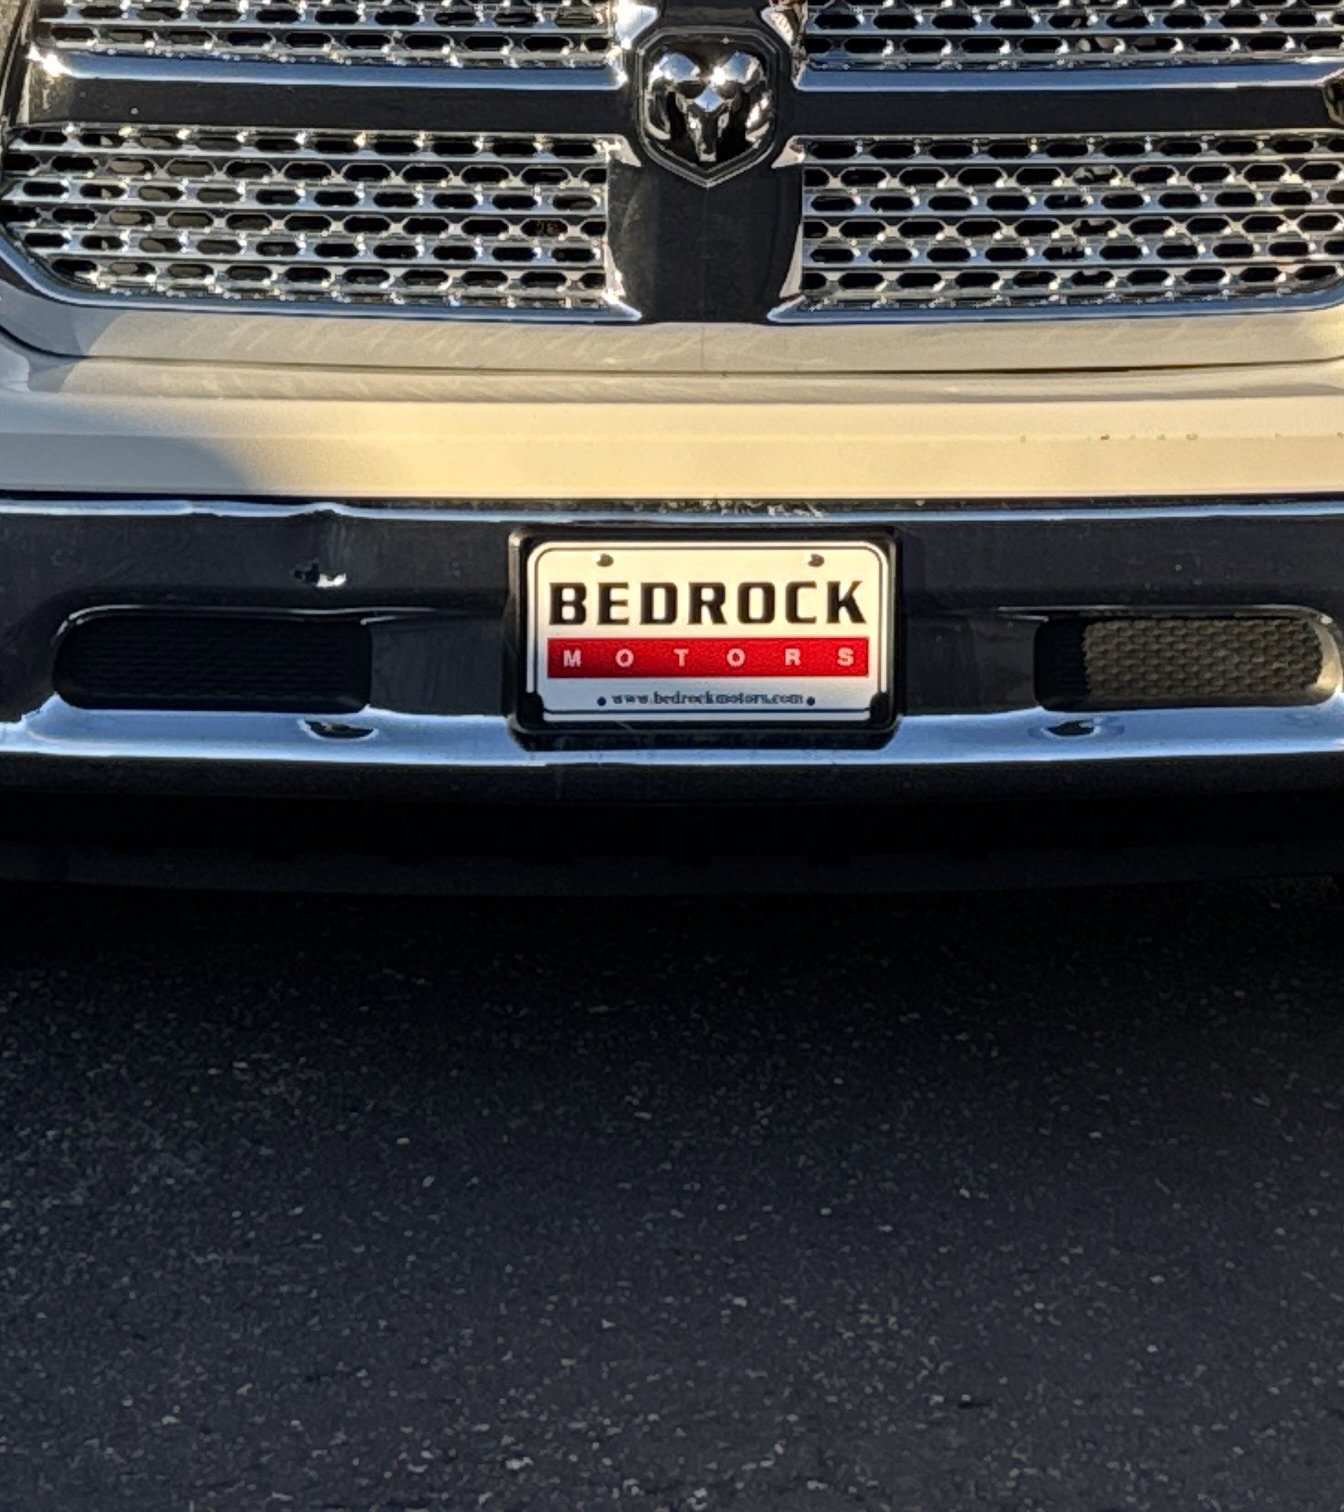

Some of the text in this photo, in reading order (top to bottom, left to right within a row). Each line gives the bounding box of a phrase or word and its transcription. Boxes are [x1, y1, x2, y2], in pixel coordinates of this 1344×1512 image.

[548, 580, 868, 626] BEDROCK
[563, 647, 855, 669] MOTORS
[611, 690, 805, 706] www.bedrockmotors.com
